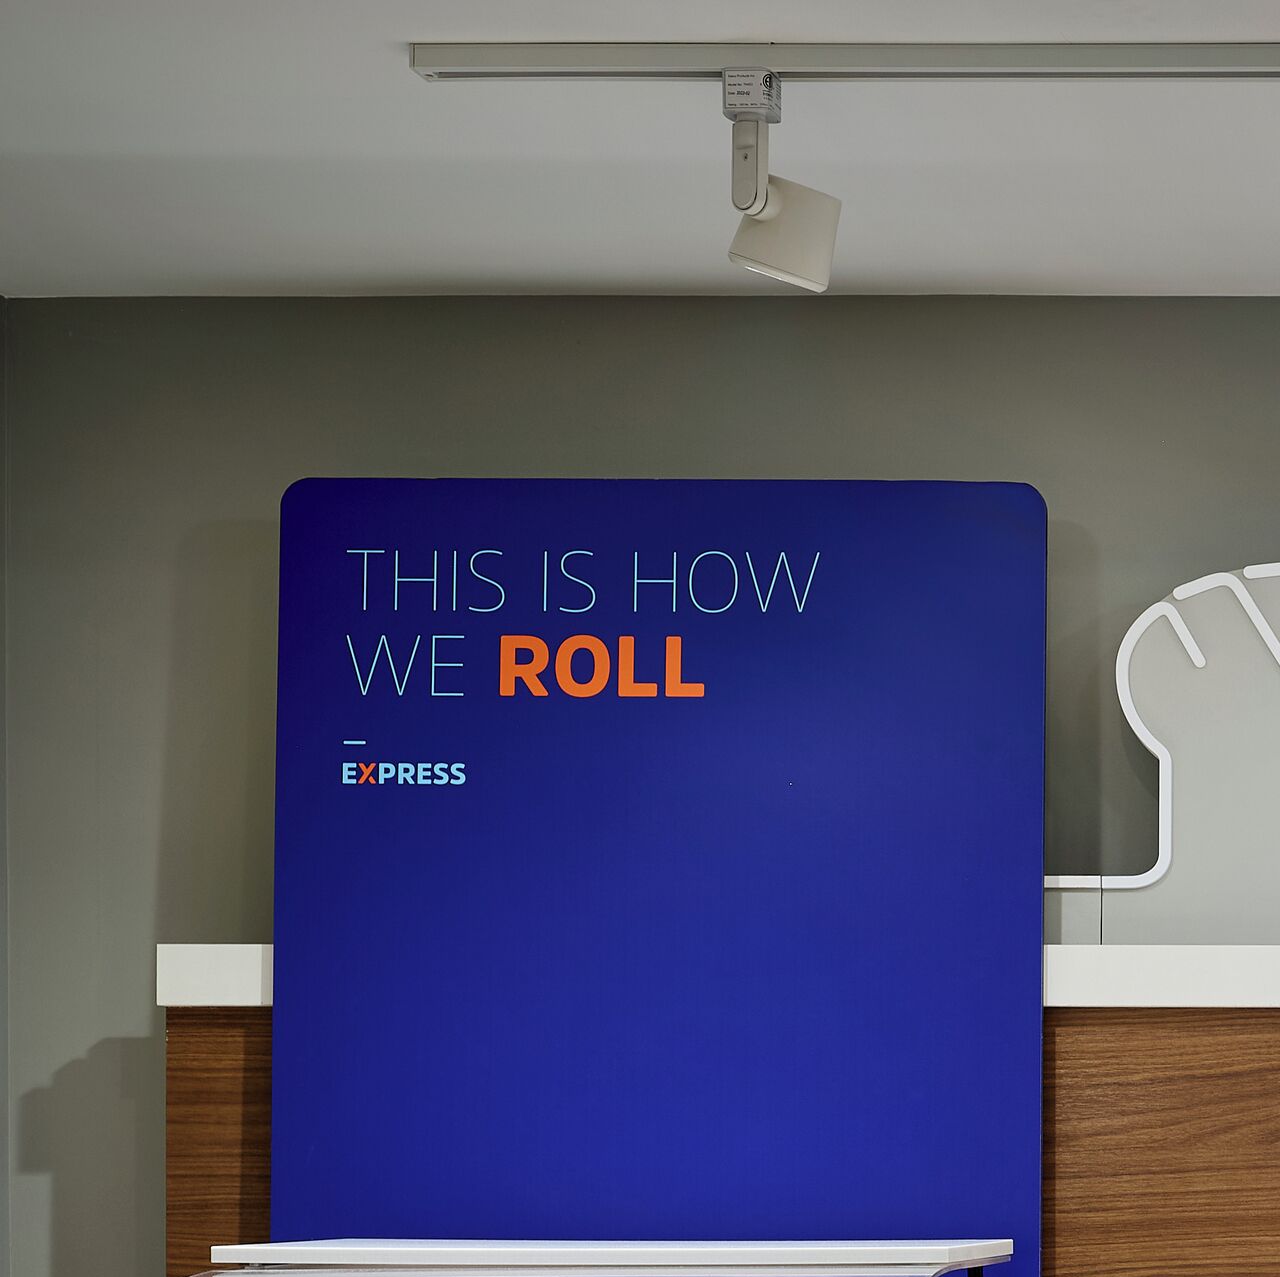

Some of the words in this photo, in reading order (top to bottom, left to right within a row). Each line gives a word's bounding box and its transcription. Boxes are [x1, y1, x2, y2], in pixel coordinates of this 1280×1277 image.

[346, 549, 506, 613] THIS
[542, 550, 596, 613] IS
[632, 549, 821, 614] HOW
[346, 634, 465, 697] WE
[499, 634, 705, 698] ROLL
[342, 762, 467, 786] EXPRESS
